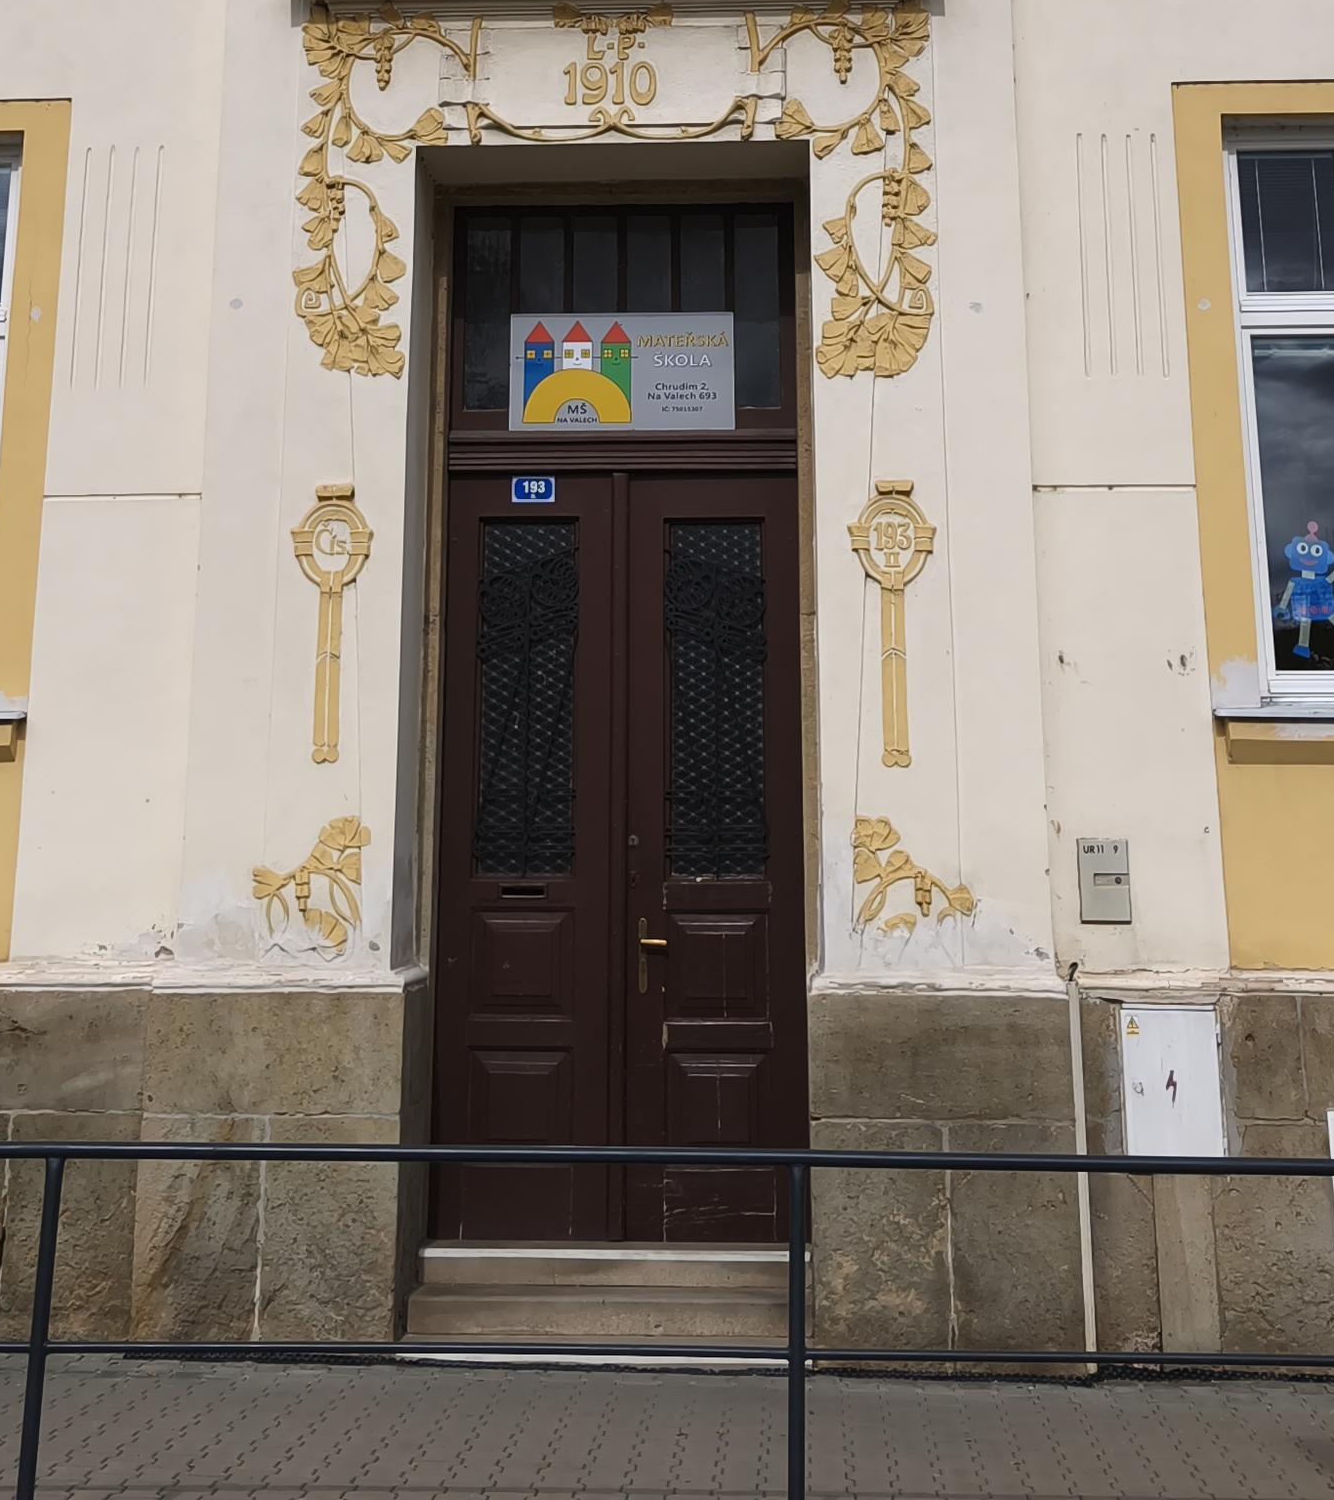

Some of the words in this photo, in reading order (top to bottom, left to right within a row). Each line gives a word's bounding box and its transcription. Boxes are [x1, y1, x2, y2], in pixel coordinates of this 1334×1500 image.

[563, 61, 657, 106] 1910
[637, 331, 729, 348] MATEŘSKÁ
[653, 351, 713, 368] ŠKOLA
[655, 382, 698, 391] Chrudim
[647, 392, 661, 401] Na
[663, 392, 697, 401] Valech
[698, 392, 717, 401] 693
[567, 402, 587, 414] MŠ
[523, 480, 545, 493] 193
[873, 521, 913, 551] 193
